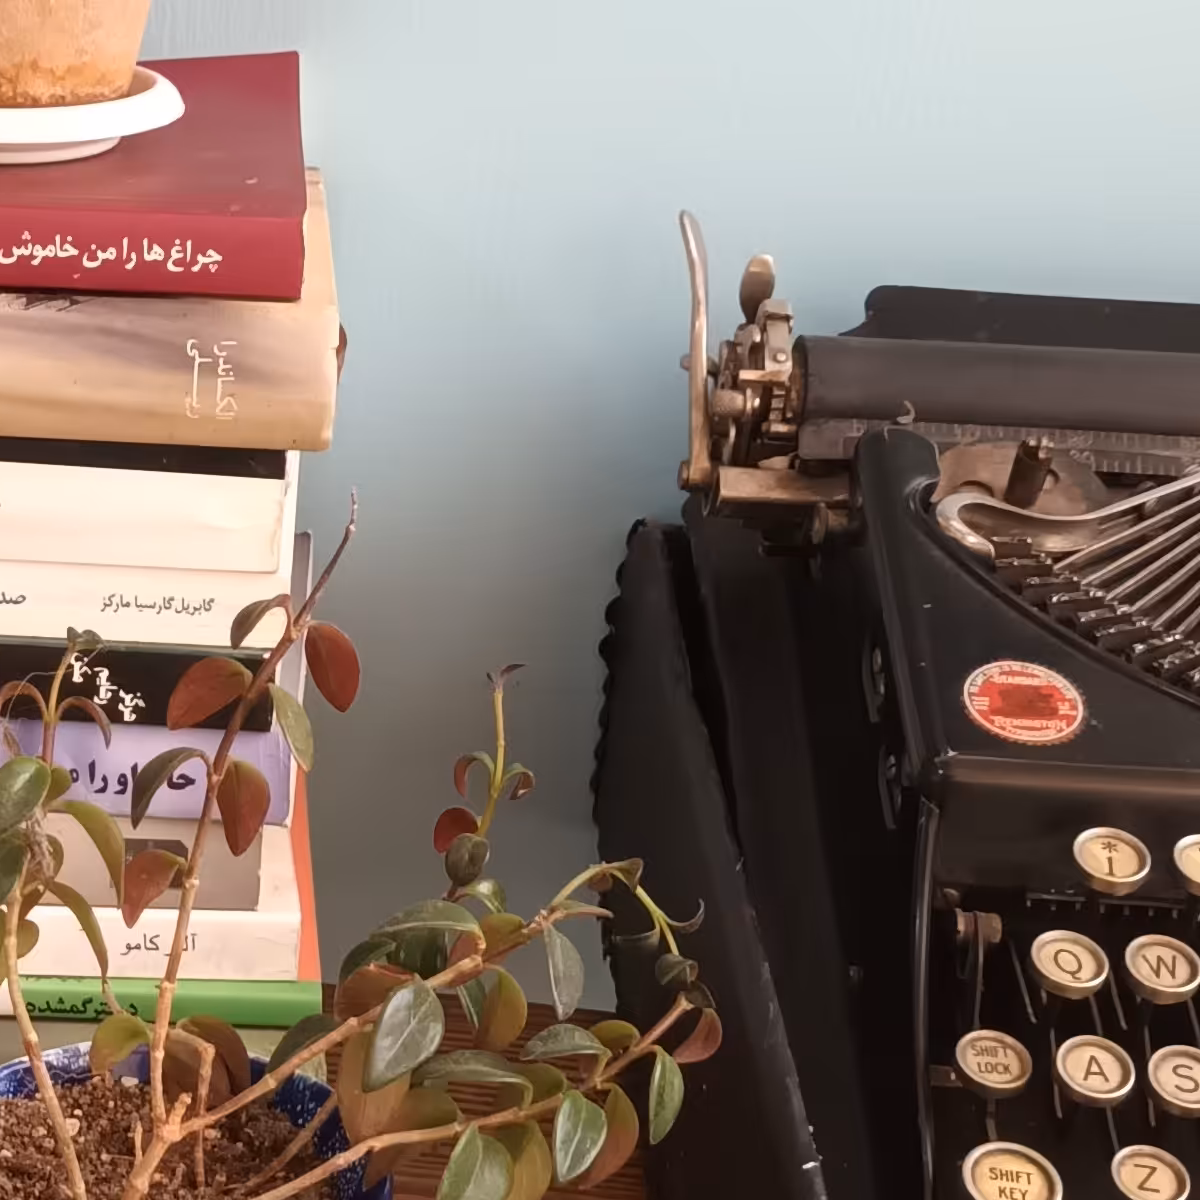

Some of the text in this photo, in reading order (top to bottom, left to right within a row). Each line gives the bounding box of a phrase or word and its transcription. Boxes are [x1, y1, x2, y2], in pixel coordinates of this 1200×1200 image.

[82, 243, 117, 268] من
[122, 237, 137, 269] را
[100, 593, 215, 615] گابریل گارسیا مارکز
[70, 652, 92, 683] مکن
[88, 759, 109, 794] را
[120, 933, 161, 956] کامو
[1053, 948, 1083, 981] Q
[1142, 953, 1177, 981] W
[970, 1044, 1008, 1059] SHIFT
[977, 1062, 1012, 1076] LOCK
[1083, 1054, 1109, 1083] A
[1172, 1063, 1200, 1094] S
[988, 1167, 1034, 1185] SHIFT
[1133, 1163, 1161, 1194] Z
